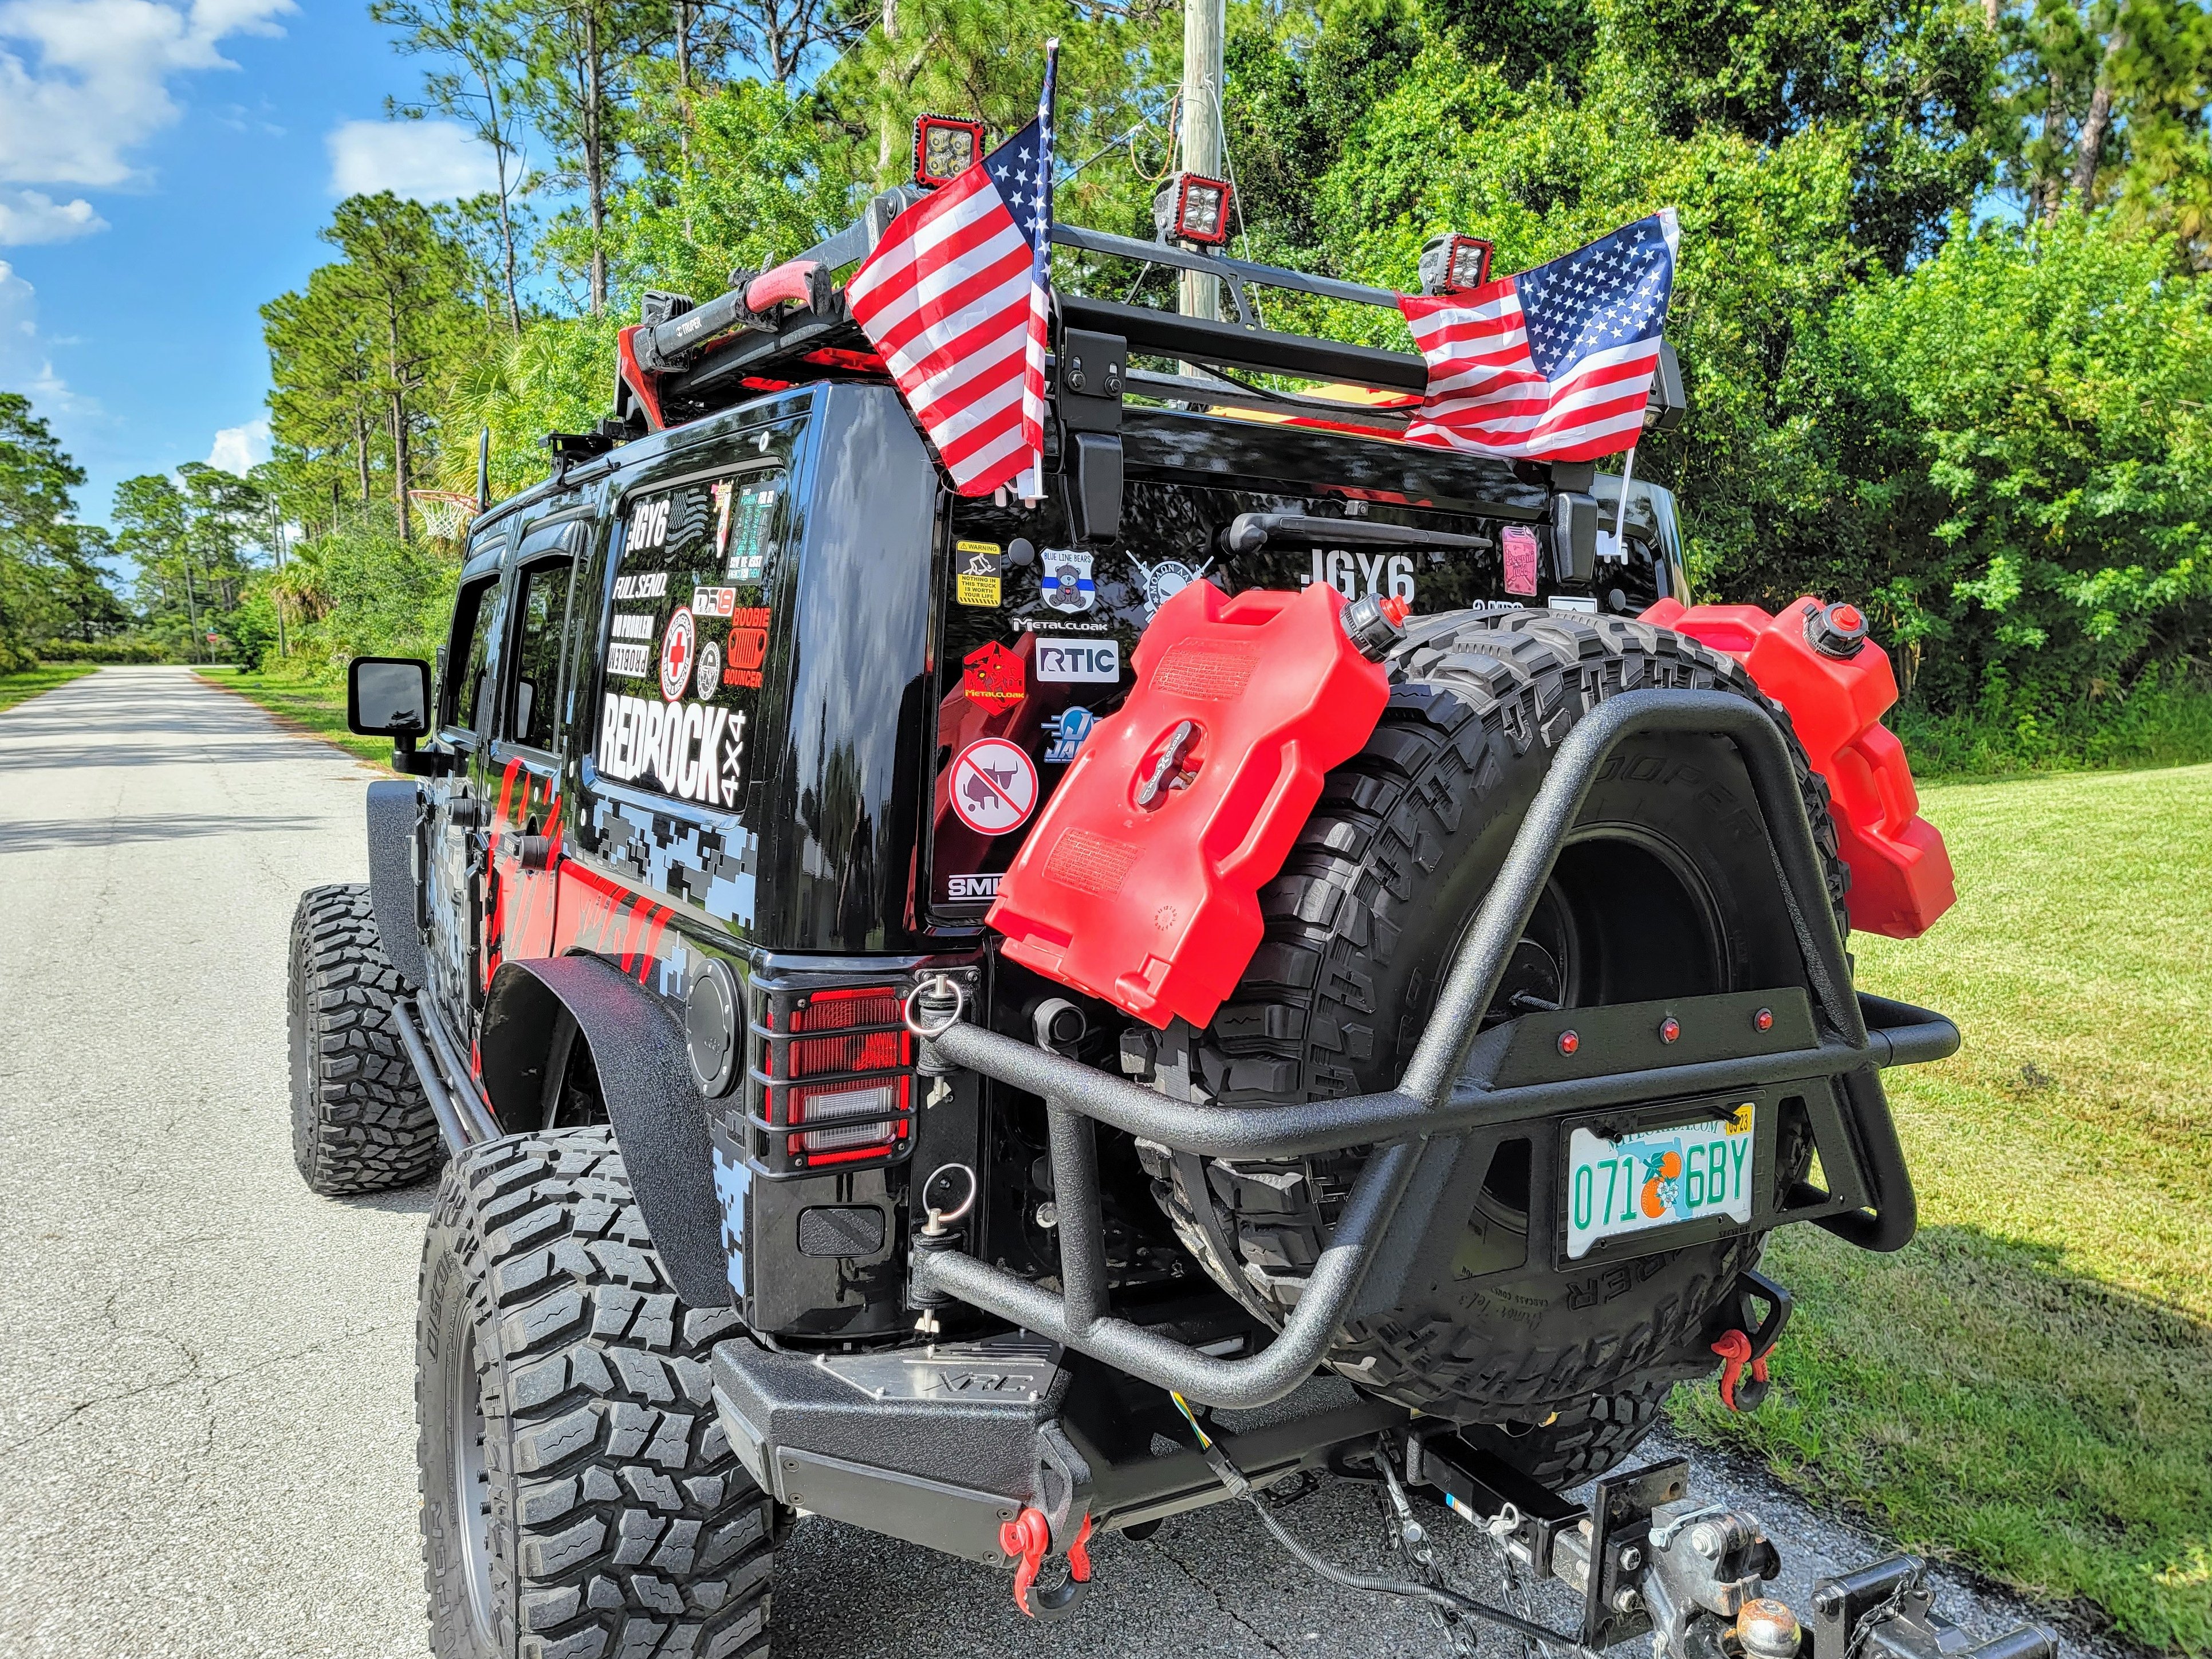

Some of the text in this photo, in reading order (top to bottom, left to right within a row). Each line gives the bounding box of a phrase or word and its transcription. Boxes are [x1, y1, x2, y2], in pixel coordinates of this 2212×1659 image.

[682, 316, 702, 335] TRUPER
[969, 544, 997, 552] WARNING
[1044, 552, 1091, 563] BLUE LINE BEARS
[612, 573, 667, 599] FULL SEND.
[612, 615, 654, 639] NO PROBLEM
[669, 615, 692, 640] EMERGENCY
[732, 607, 771, 627] BOOBIE
[608, 647, 648, 673] PROBLEM
[1040, 647, 1115, 673] RTIC
[663, 656, 672, 693] SEARCH
[675, 656, 690, 693] RESCUE
[723, 668, 763, 687] BOUNCER
[599, 693, 729, 804] REDROCK
[948, 878, 1002, 896] SMI
[1574, 1137, 1749, 1230] 071 6BY
[922, 1370, 1034, 1392] XRC
